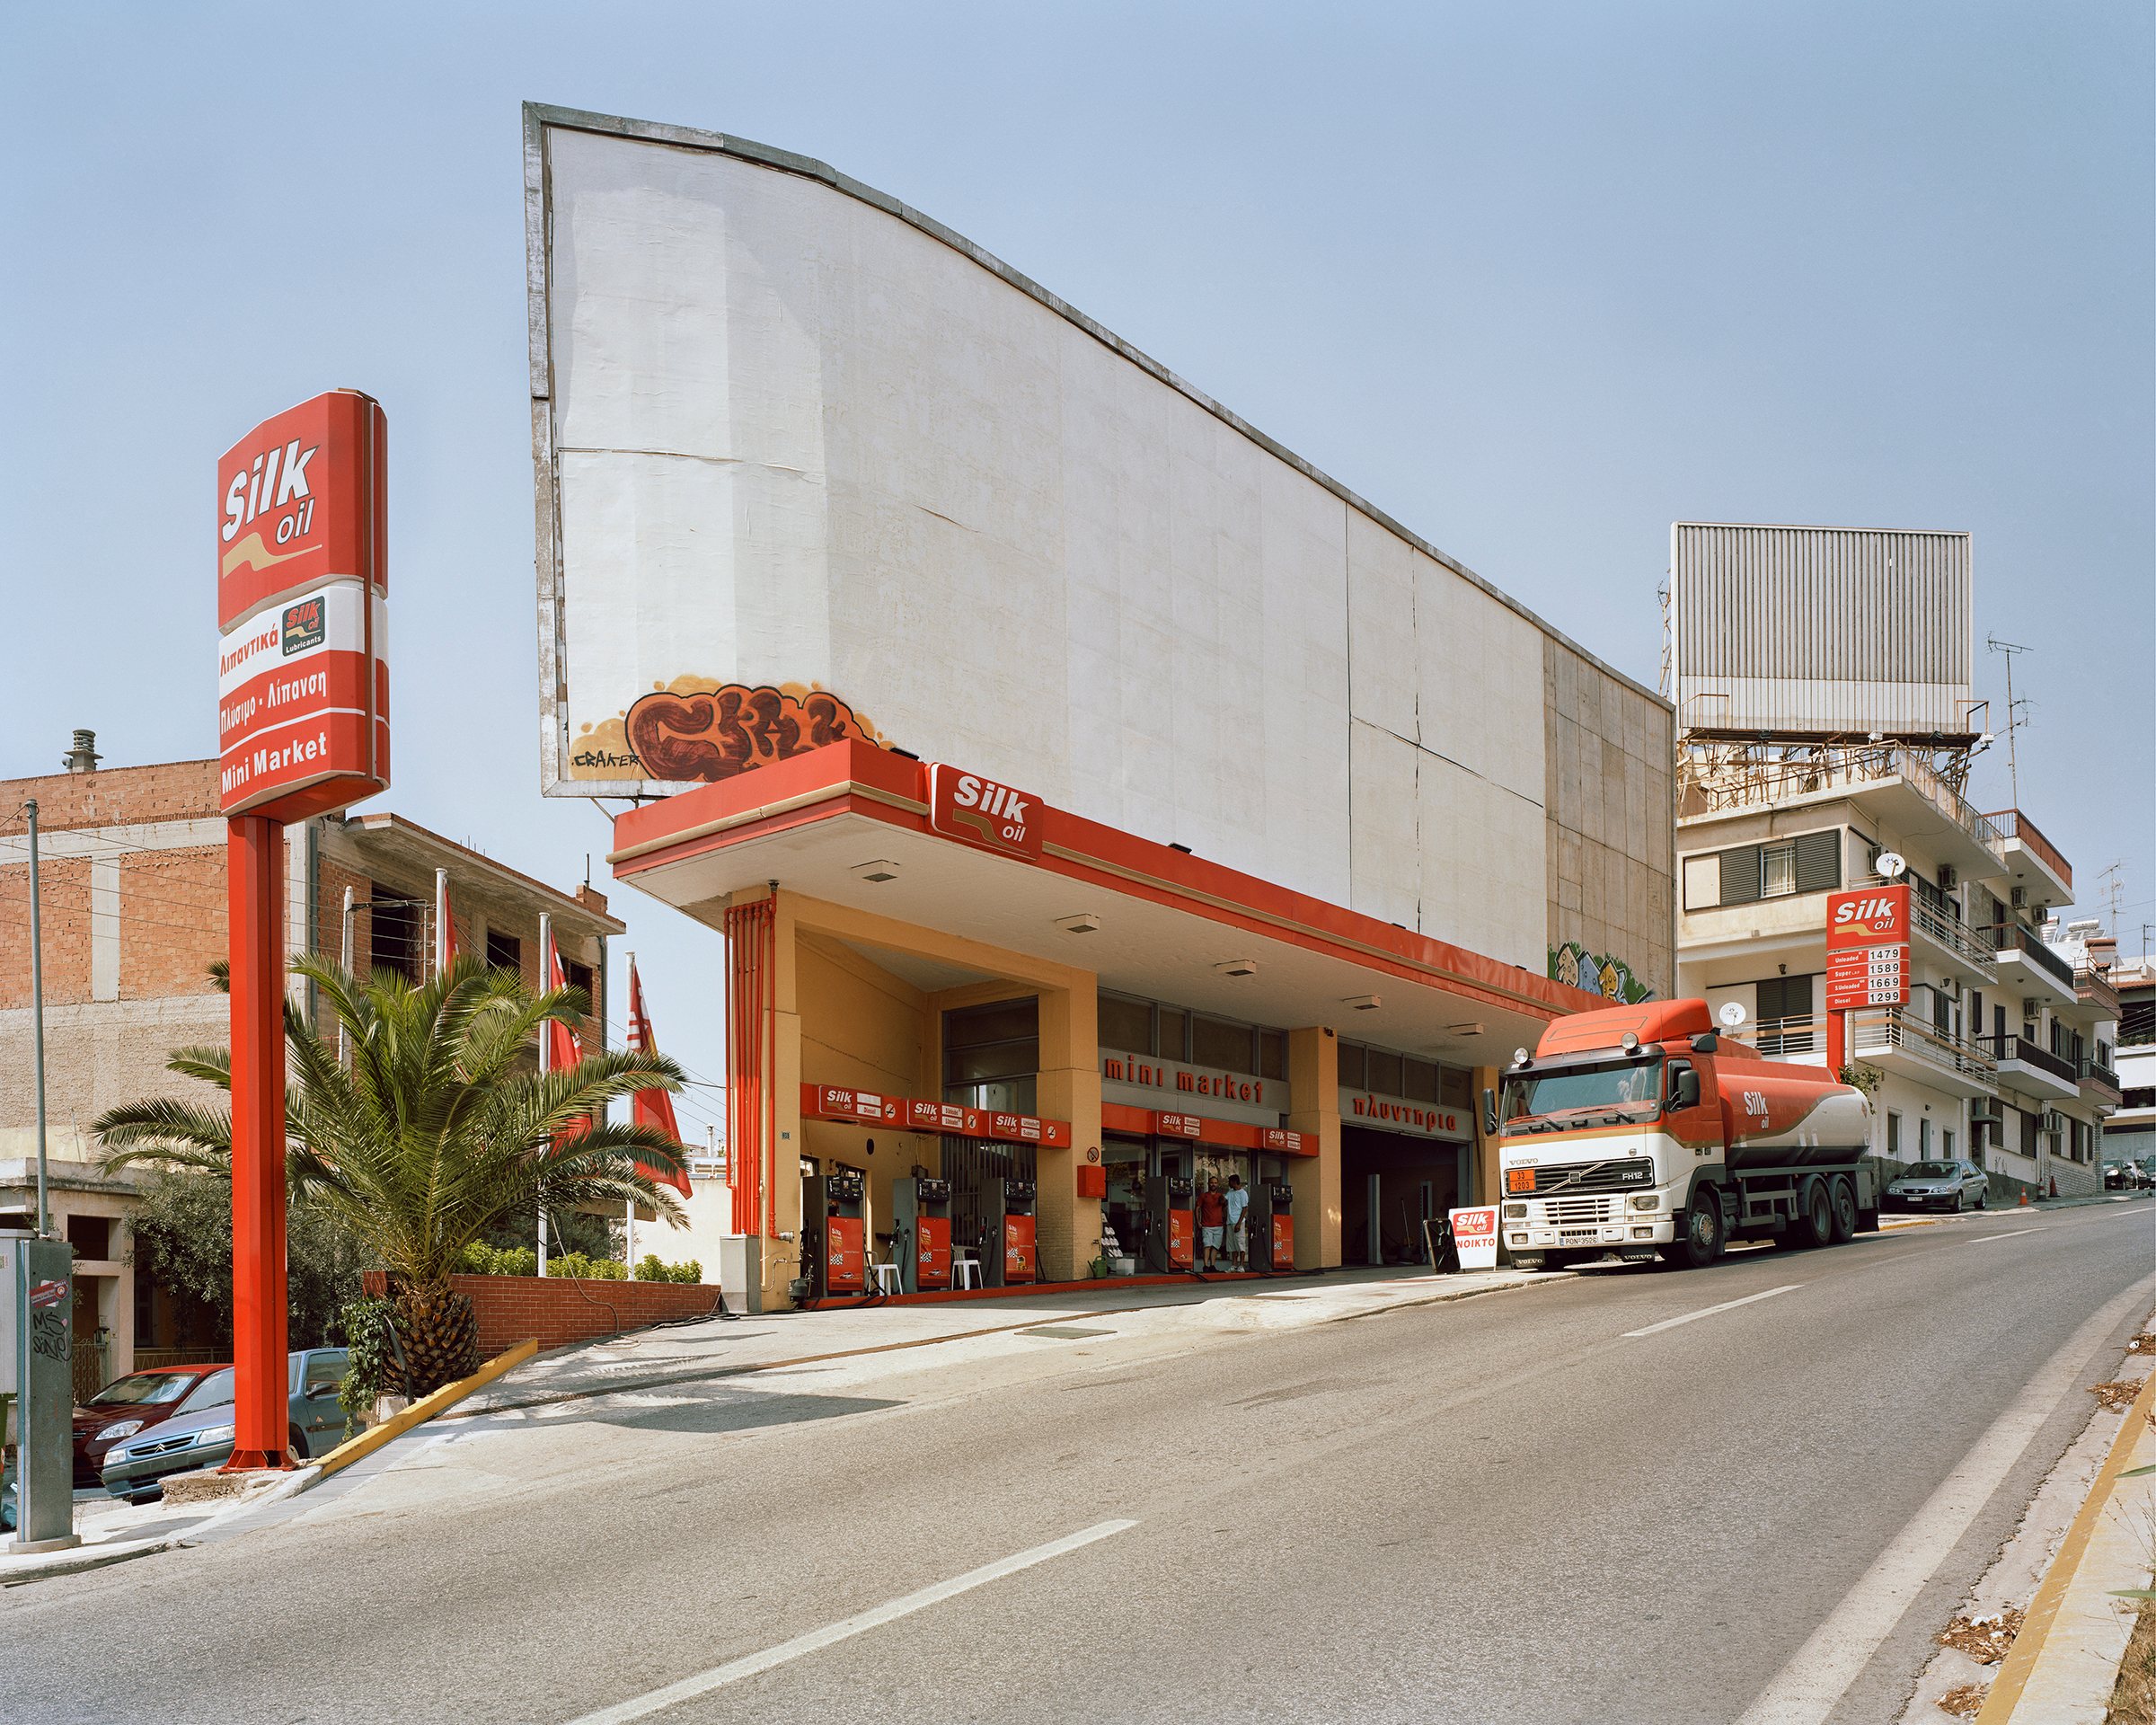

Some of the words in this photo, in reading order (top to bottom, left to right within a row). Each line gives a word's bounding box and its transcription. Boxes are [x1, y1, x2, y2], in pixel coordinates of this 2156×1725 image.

[222, 438, 320, 543] Silk
[276, 497, 315, 544] oil
[286, 601, 322, 629] Silk
[308, 617, 319, 631] oil
[220, 623, 278, 677] Λιπαντικά
[286, 635, 322, 653] Lubricants
[220, 702, 255, 735] Πλύσιμο
[268, 671, 326, 708] Λίπανση
[221, 756, 250, 794] Mini
[253, 731, 326, 776] Market
[954, 775, 1029, 824] Silk
[1003, 825, 1027, 842] oil
[1834, 898, 1897, 924] Silk
[1874, 917, 1895, 930] oil
[1834, 955, 1859, 963] Unleaded
[1106, 1055, 1162, 1087] mini
[1178, 1072, 1262, 1103] market
[826, 1090, 852, 1103] Silk
[915, 1102, 938, 1115] Silk
[1744, 1091, 1769, 1116] Silk
[996, 1115, 1017, 1127] Silk
[1162, 1115, 1181, 1126] Silk
[1761, 1116, 1770, 1128] oil
[1269, 1130, 1285, 1141] Silk
[1509, 1157, 1539, 1166] VOLVO
[1516, 1172, 1525, 1180] 33
[1621, 1172, 1643, 1181] FH12
[1515, 1181, 1530, 1190] 1203
[1456, 1213, 1489, 1225] Silk
[1624, 1253, 1652, 1261] VOLVO
